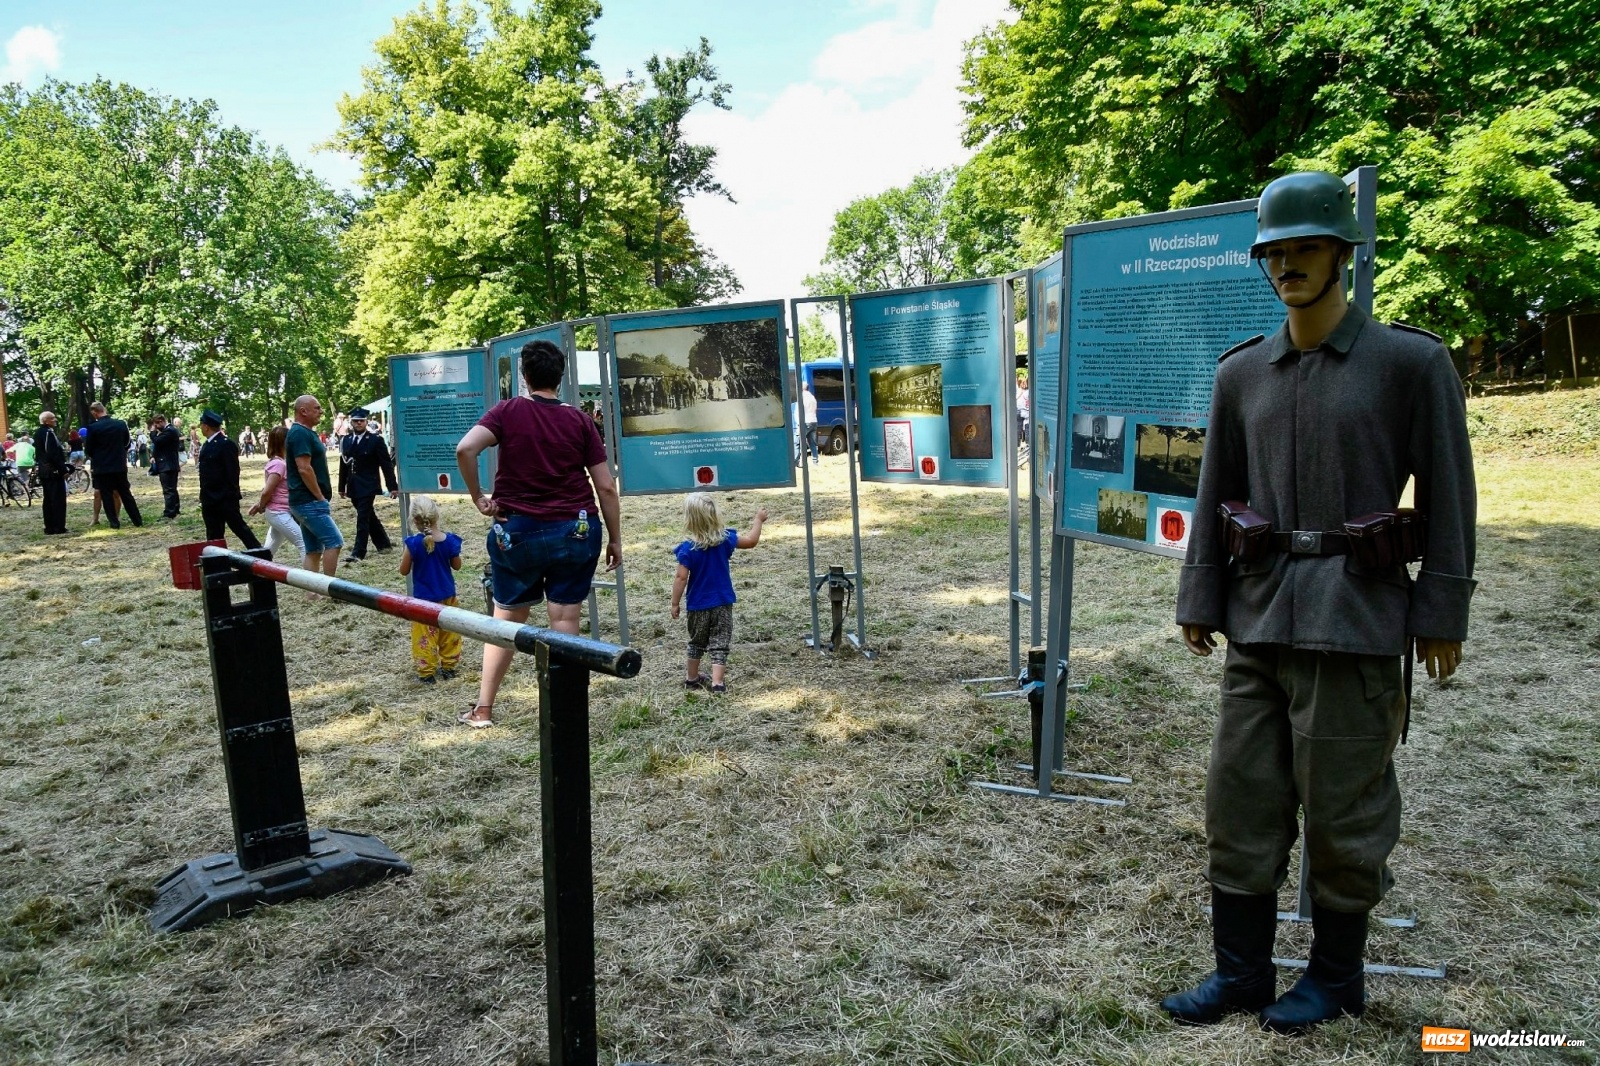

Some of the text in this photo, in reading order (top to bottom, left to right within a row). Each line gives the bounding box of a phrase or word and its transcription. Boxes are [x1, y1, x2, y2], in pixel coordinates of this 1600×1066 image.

[1149, 232, 1219, 252] Wodzisław
[1121, 249, 1251, 274] w II Rzeczpospolitej
[885, 299, 960, 316] II Powstanie Śląskie
